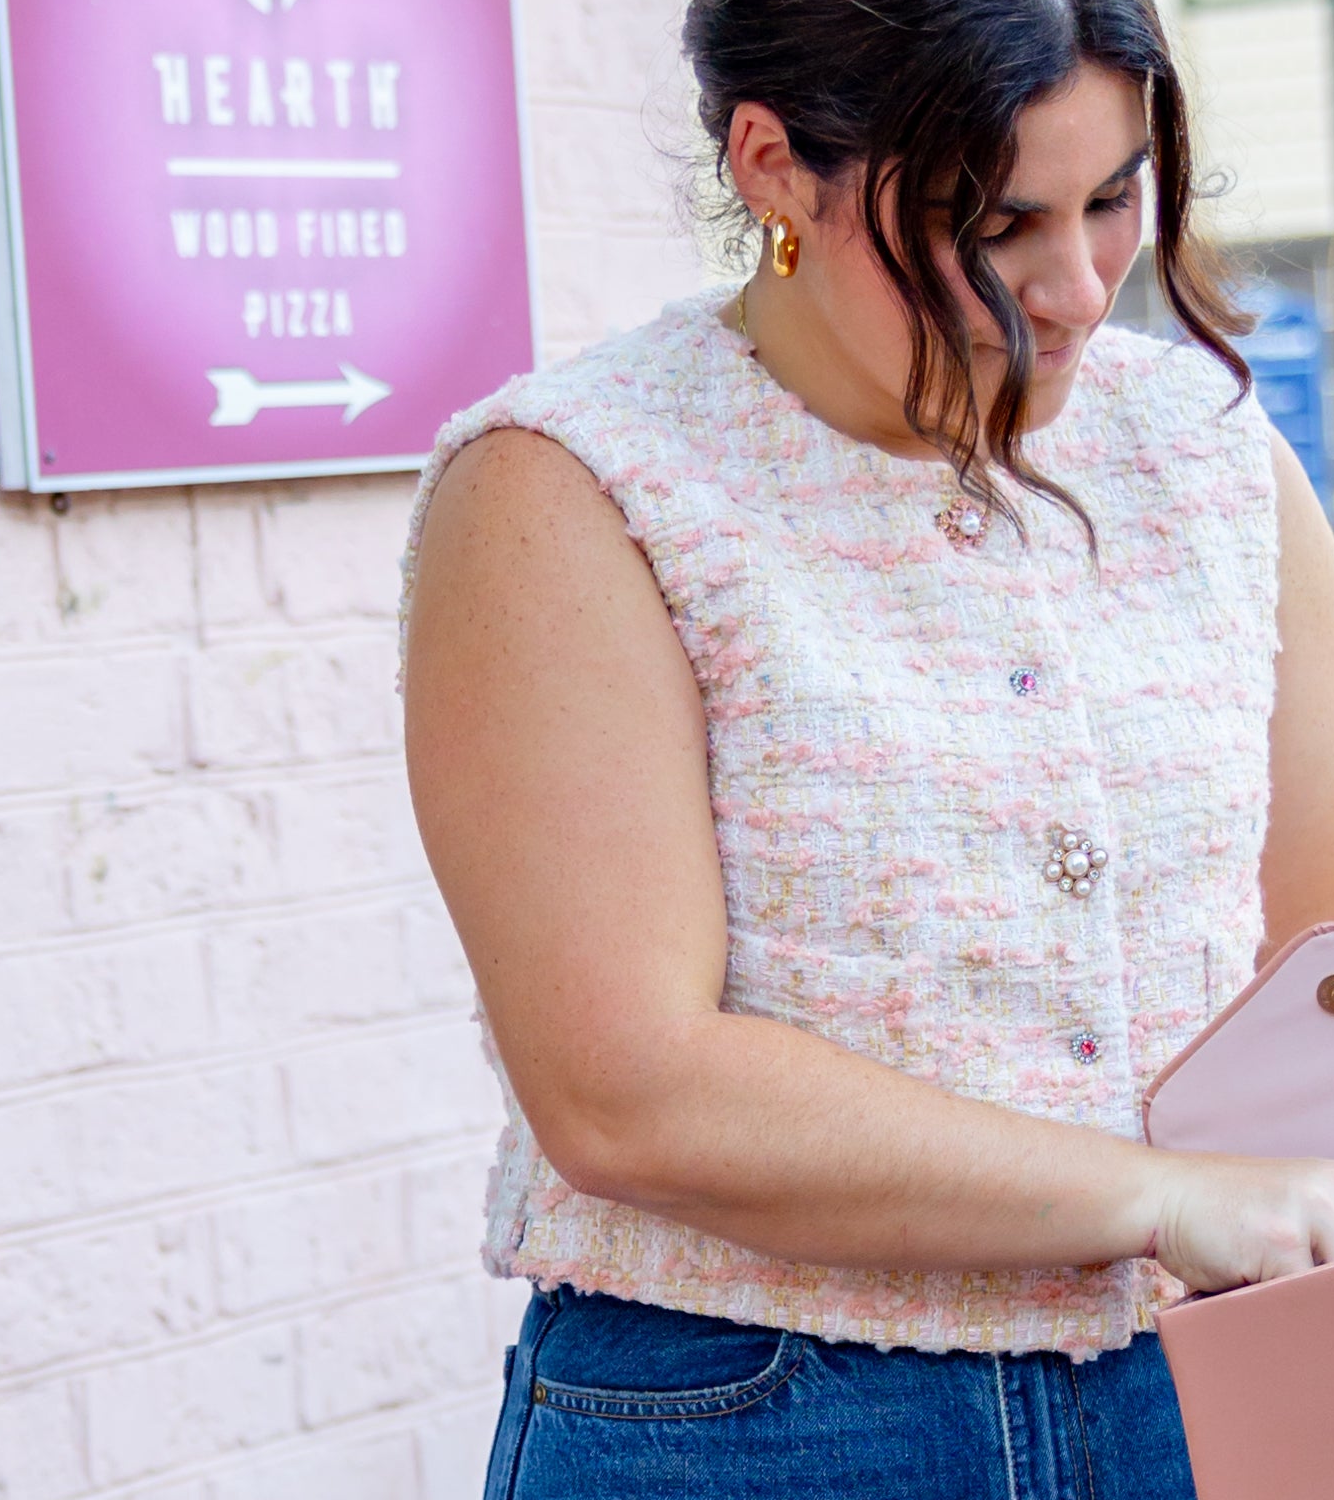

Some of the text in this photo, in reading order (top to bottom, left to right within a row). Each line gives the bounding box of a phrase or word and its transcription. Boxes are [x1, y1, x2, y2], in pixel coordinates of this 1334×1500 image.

[153, 53, 400, 130] HEARTH
[171, 210, 406, 258] WOOD FIRED
[243, 290, 352, 338] PIZZA
